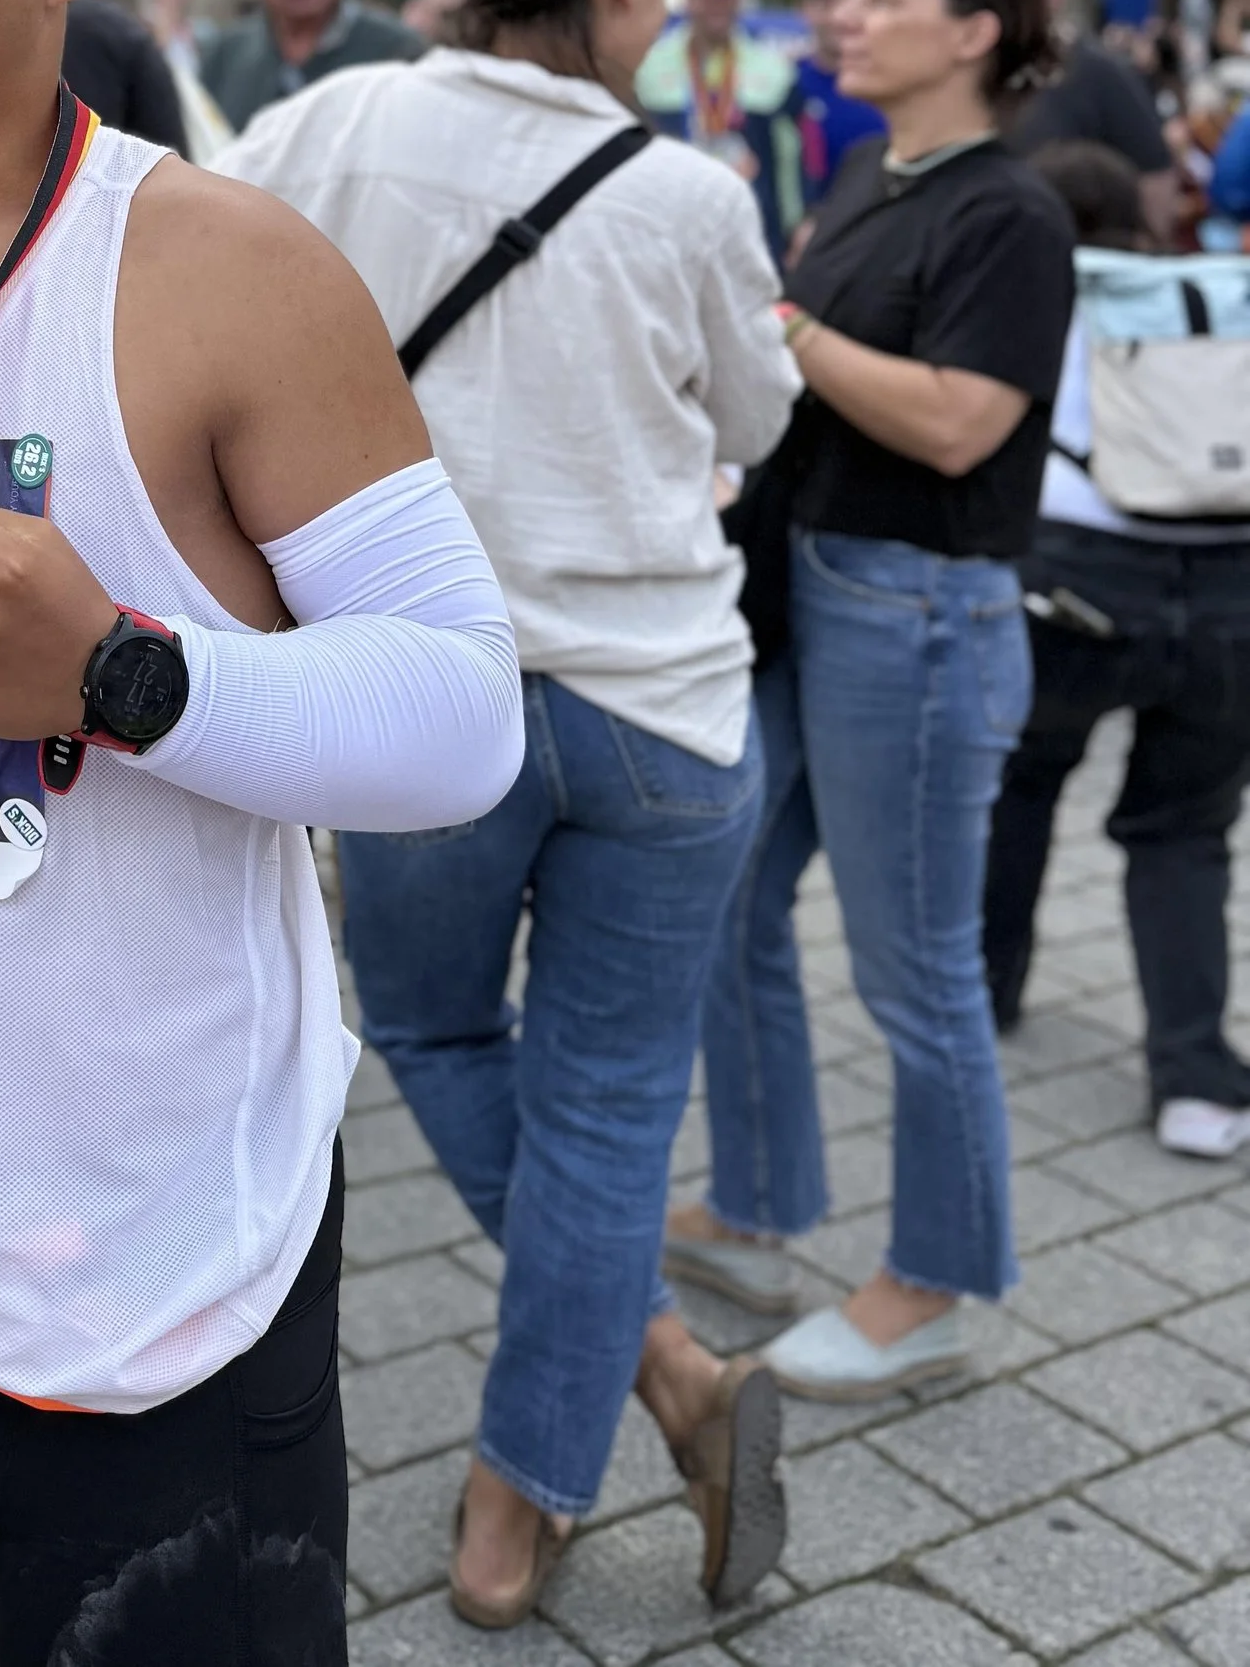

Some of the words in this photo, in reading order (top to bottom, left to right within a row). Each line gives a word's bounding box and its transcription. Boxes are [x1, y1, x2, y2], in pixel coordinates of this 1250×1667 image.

[20, 442, 42, 477] 26.2
[38, 452, 49, 473] DICK'S
[7, 807, 40, 845] DICK'S
